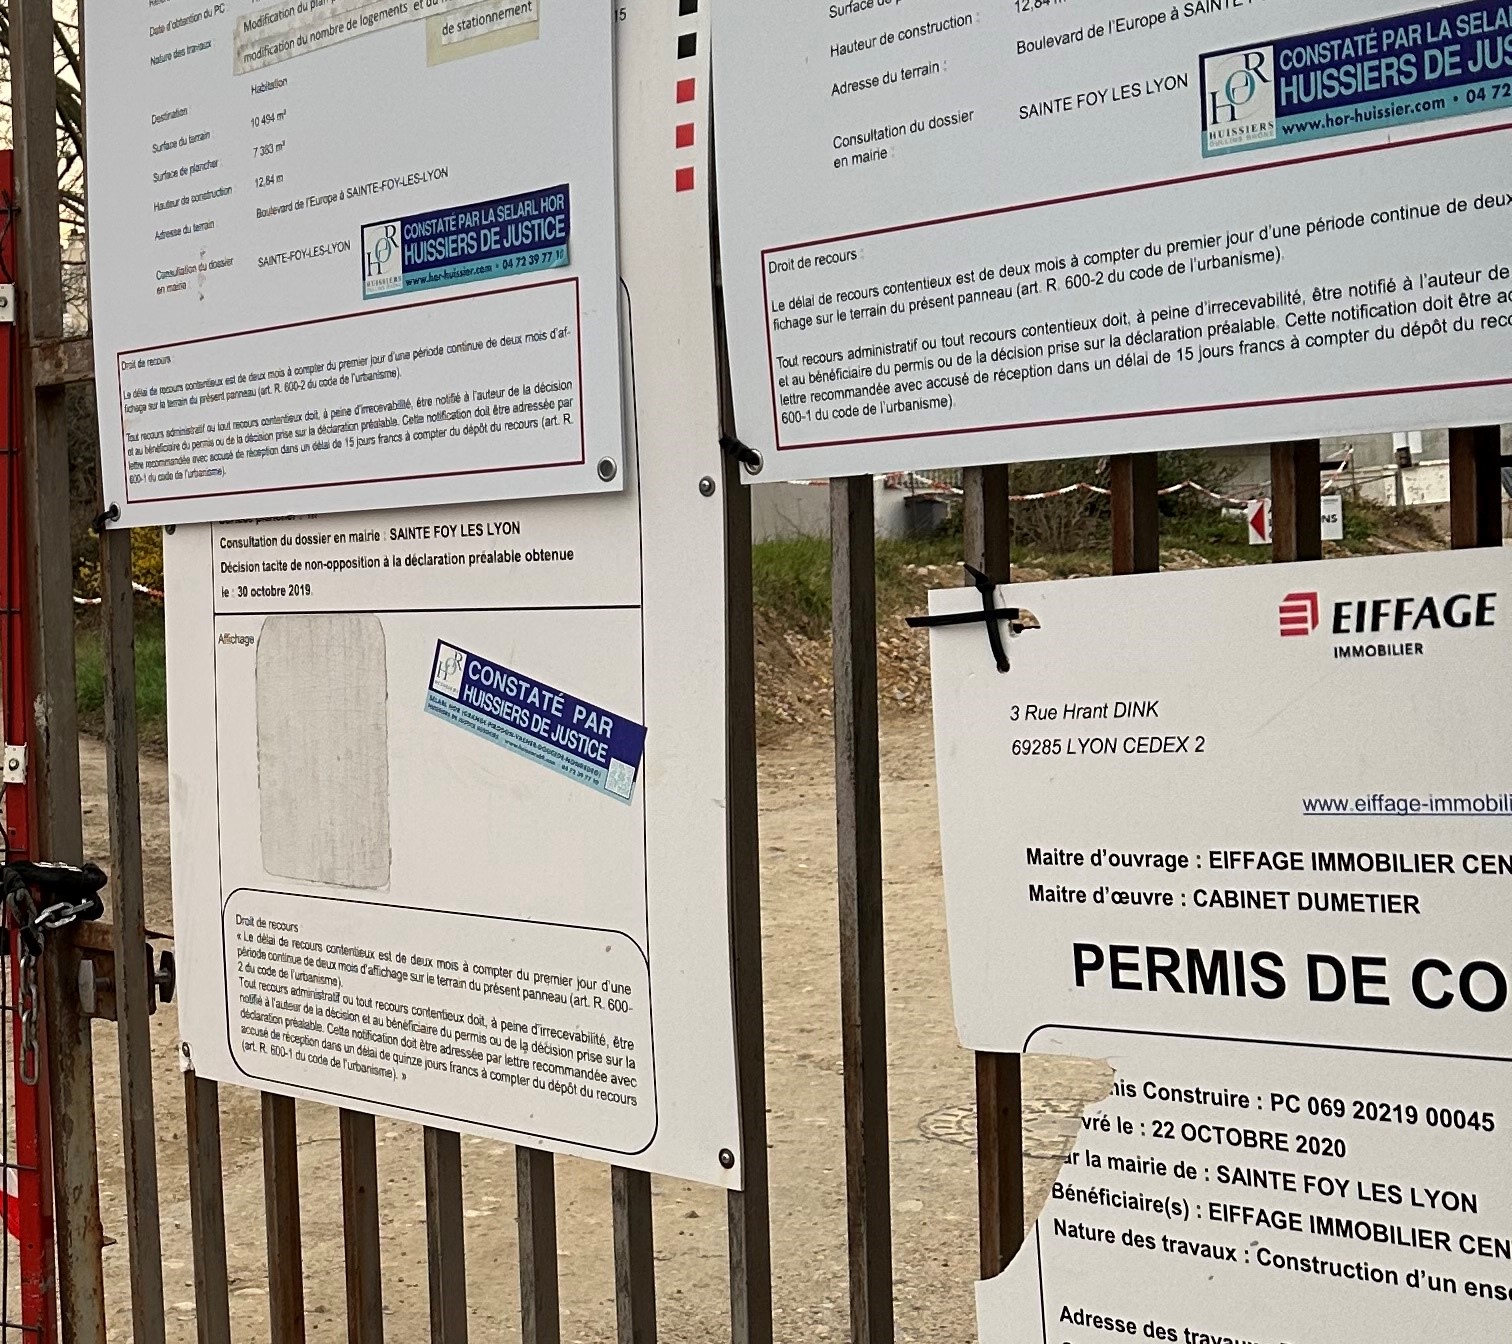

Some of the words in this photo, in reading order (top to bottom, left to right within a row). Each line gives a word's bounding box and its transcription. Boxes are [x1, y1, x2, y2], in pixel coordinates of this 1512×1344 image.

[243, 6, 295, 33] Modification
[296, 0, 309, 14] du
[243, 39, 295, 63] modification
[296, 32, 308, 47] du
[310, 24, 345, 43] nombre
[346, 18, 358, 31] de
[360, 2, 408, 27] logements
[413, 0, 424, 11] et
[441, 21, 455, 37] de
[456, 0, 533, 33] stationnement
[1016, 26, 1084, 55] Boulevard
[1087, 23, 1105, 39] de
[1170, 5, 1180, 21] à
[1279, 28, 1379, 71] CONSTATÉ
[1382, 23, 1423, 52] PAR
[1426, 18, 1452, 43] LA
[1280, 53, 1418, 106] HUISSIERS
[1423, 43, 1462, 81] DE
[346, 166, 449, 199] SAINTE-FOY-LES-LYON
[403, 211, 457, 240] CONSTATÉ
[458, 210, 480, 230] PAR
[481, 207, 496, 225] LA
[496, 199, 539, 222] SELARL
[540, 193, 565, 214] HOR
[404, 231, 478, 266] HUISSIERS
[480, 226, 501, 252] DE
[502, 214, 566, 248] JUSTICE
[219, 535, 278, 549] Consultation
[280, 533, 293, 547] du
[294, 532, 332, 546] dossier
[333, 533, 347, 544] en
[348, 529, 381, 544] mairie
[389, 525, 431, 541] SAINTE
[433, 524, 458, 539] FOY
[460, 522, 484, 538] LES
[486, 520, 521, 536] LYON
[221, 586, 231, 599] le
[237, 585, 249, 598] 30
[250, 584, 288, 598] octobre
[288, 583, 312, 598] 2019
[1332, 592, 1497, 635] EIFFAGE
[1333, 642, 1424, 659] IMMOBILIER
[468, 660, 565, 718] CONSTATÉ
[572, 704, 613, 739] PAR
[1009, 705, 1020, 722] 3
[1024, 704, 1058, 721] Rue
[1062, 702, 1109, 720] Hrant
[1113, 700, 1160, 719] DINK
[463, 683, 530, 728] HUISSIERS
[530, 713, 551, 738] DE
[550, 723, 609, 764] JUSTICE
[1011, 738, 1062, 756] 69285
[1066, 737, 1118, 755] LYON
[1122, 735, 1190, 754] CEDEX
[1194, 735, 1206, 753] 2
[1026, 847, 1085, 867] Maitre
[1208, 850, 1305, 871] EIFFAGE
[1311, 851, 1456, 874] IMMOBILIER
[1028, 884, 1087, 904] Maitre
[1193, 888, 1291, 910] CABINET
[1297, 891, 1421, 915] DUMETIER
[1072, 942, 1286, 1000] PERMIS
[1306, 953, 1391, 1006] DE
[1411, 958, 1508, 1013] CO
[1142, 1081, 1250, 1109] Construire
[1270, 1092, 1301, 1114] PC
[1307, 1096, 1346, 1118] 069
[1352, 1100, 1418, 1125] 20219
[1425, 1106, 1495, 1133] 00045
[1116, 1115, 1134, 1135] le
[1151, 1119, 1176, 1140] 22
[1180, 1122, 1290, 1153] OCTOBRE
[1295, 1134, 1346, 1158] 2020
[1085, 1149, 1102, 1169] la
[1107, 1155, 1167, 1177] mairie
[1173, 1160, 1198, 1180] de
[1216, 1164, 1297, 1193] SAINTE
[1303, 1174, 1350, 1198] FOY
[1357, 1180, 1403, 1205] LES
[1410, 1187, 1478, 1214] LYON
